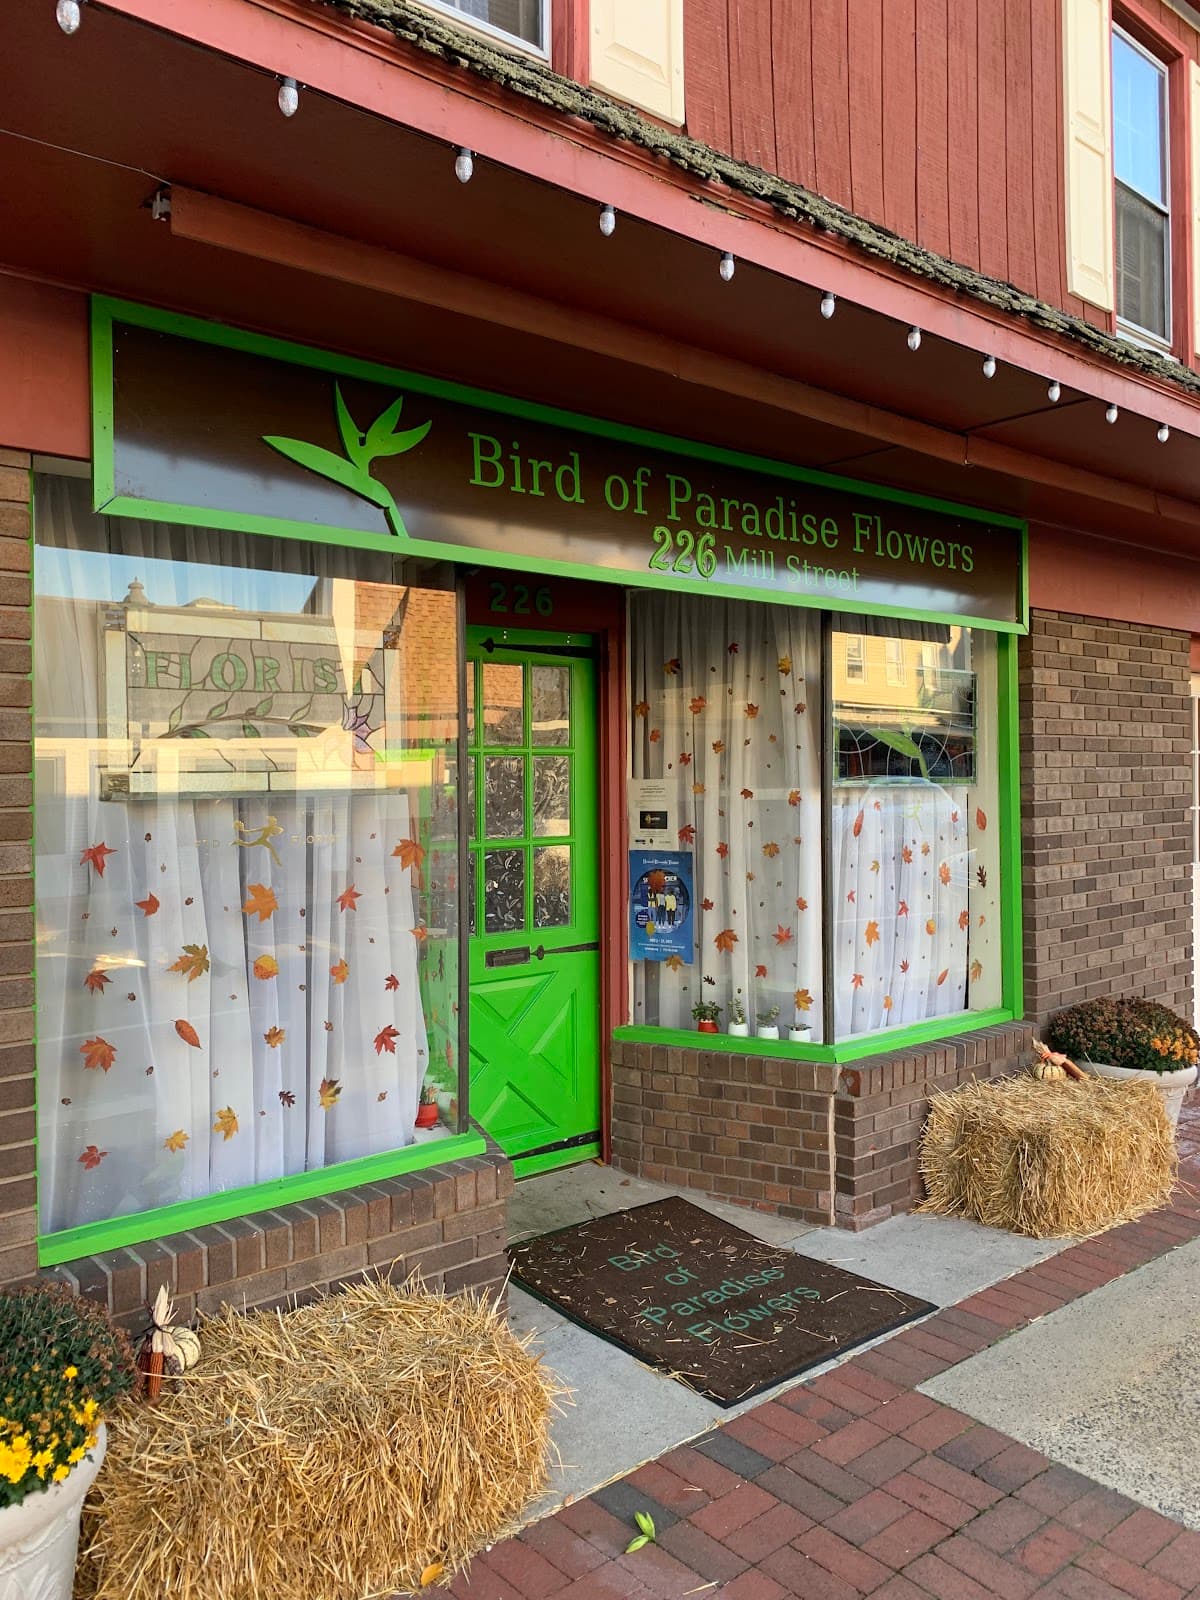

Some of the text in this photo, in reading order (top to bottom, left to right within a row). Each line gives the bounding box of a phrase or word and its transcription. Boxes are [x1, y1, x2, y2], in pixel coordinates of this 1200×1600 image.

[467, 431, 975, 573] Bird of Paradise Flowers
[648, 525, 861, 593] 226 Mill Street
[489, 581, 555, 617] 226
[608, 1243, 679, 1272] Bird
[664, 1266, 699, 1286] of
[641, 1268, 785, 1325] Paradise
[686, 1286, 821, 1343] Flowers
